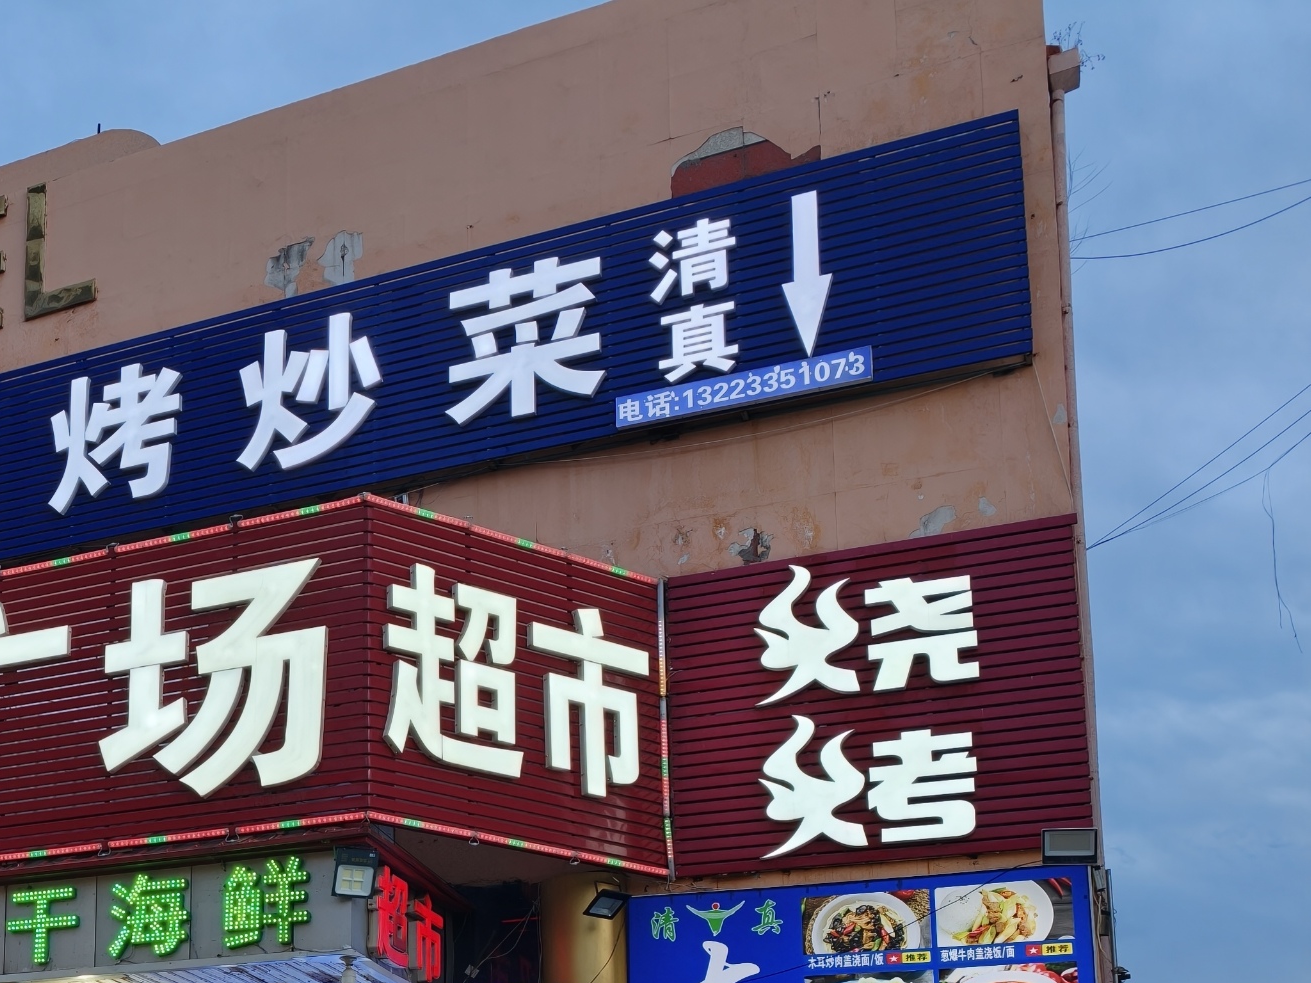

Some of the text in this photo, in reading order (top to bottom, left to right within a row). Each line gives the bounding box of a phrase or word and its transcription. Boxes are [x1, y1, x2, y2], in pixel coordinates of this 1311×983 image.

[648, 218, 740, 384] 清真
[382, 562, 650, 799] 超市
[753, 564, 981, 860] 烧烤
[6, 855, 312, 966] 干海鲜
[808, 952, 929, 969] 木耳炒肉盖浇面/饭 推荐
[1046, 944, 1070, 955] 推荐
